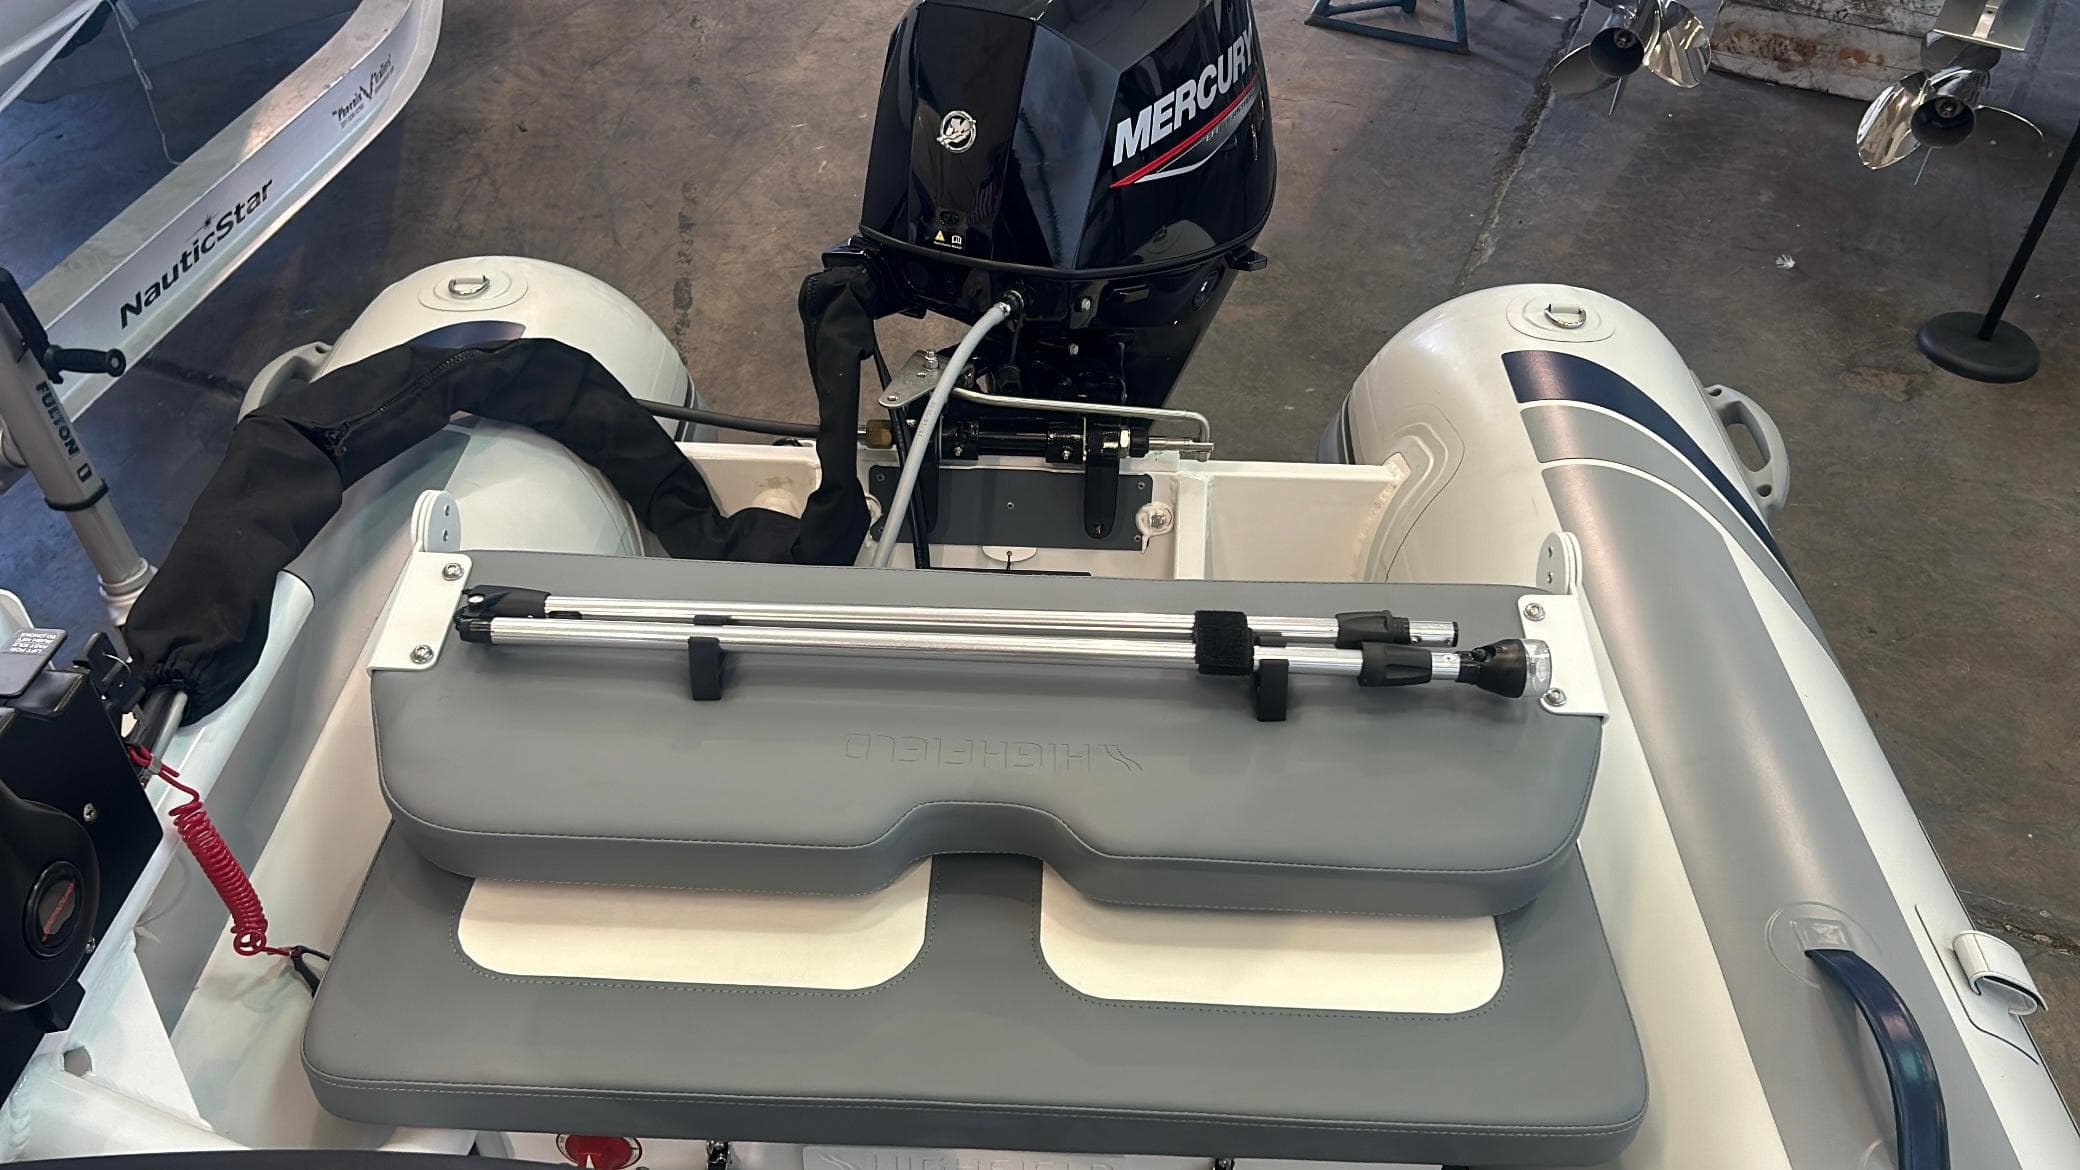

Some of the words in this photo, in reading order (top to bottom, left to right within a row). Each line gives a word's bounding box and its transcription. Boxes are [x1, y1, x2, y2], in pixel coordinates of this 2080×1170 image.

[1113, 30, 1252, 167] MERCURY
[120, 179, 273, 330] NauticStar
[36, 381, 80, 456] FULTON
[842, 734, 1090, 776] HIGHFIELD
